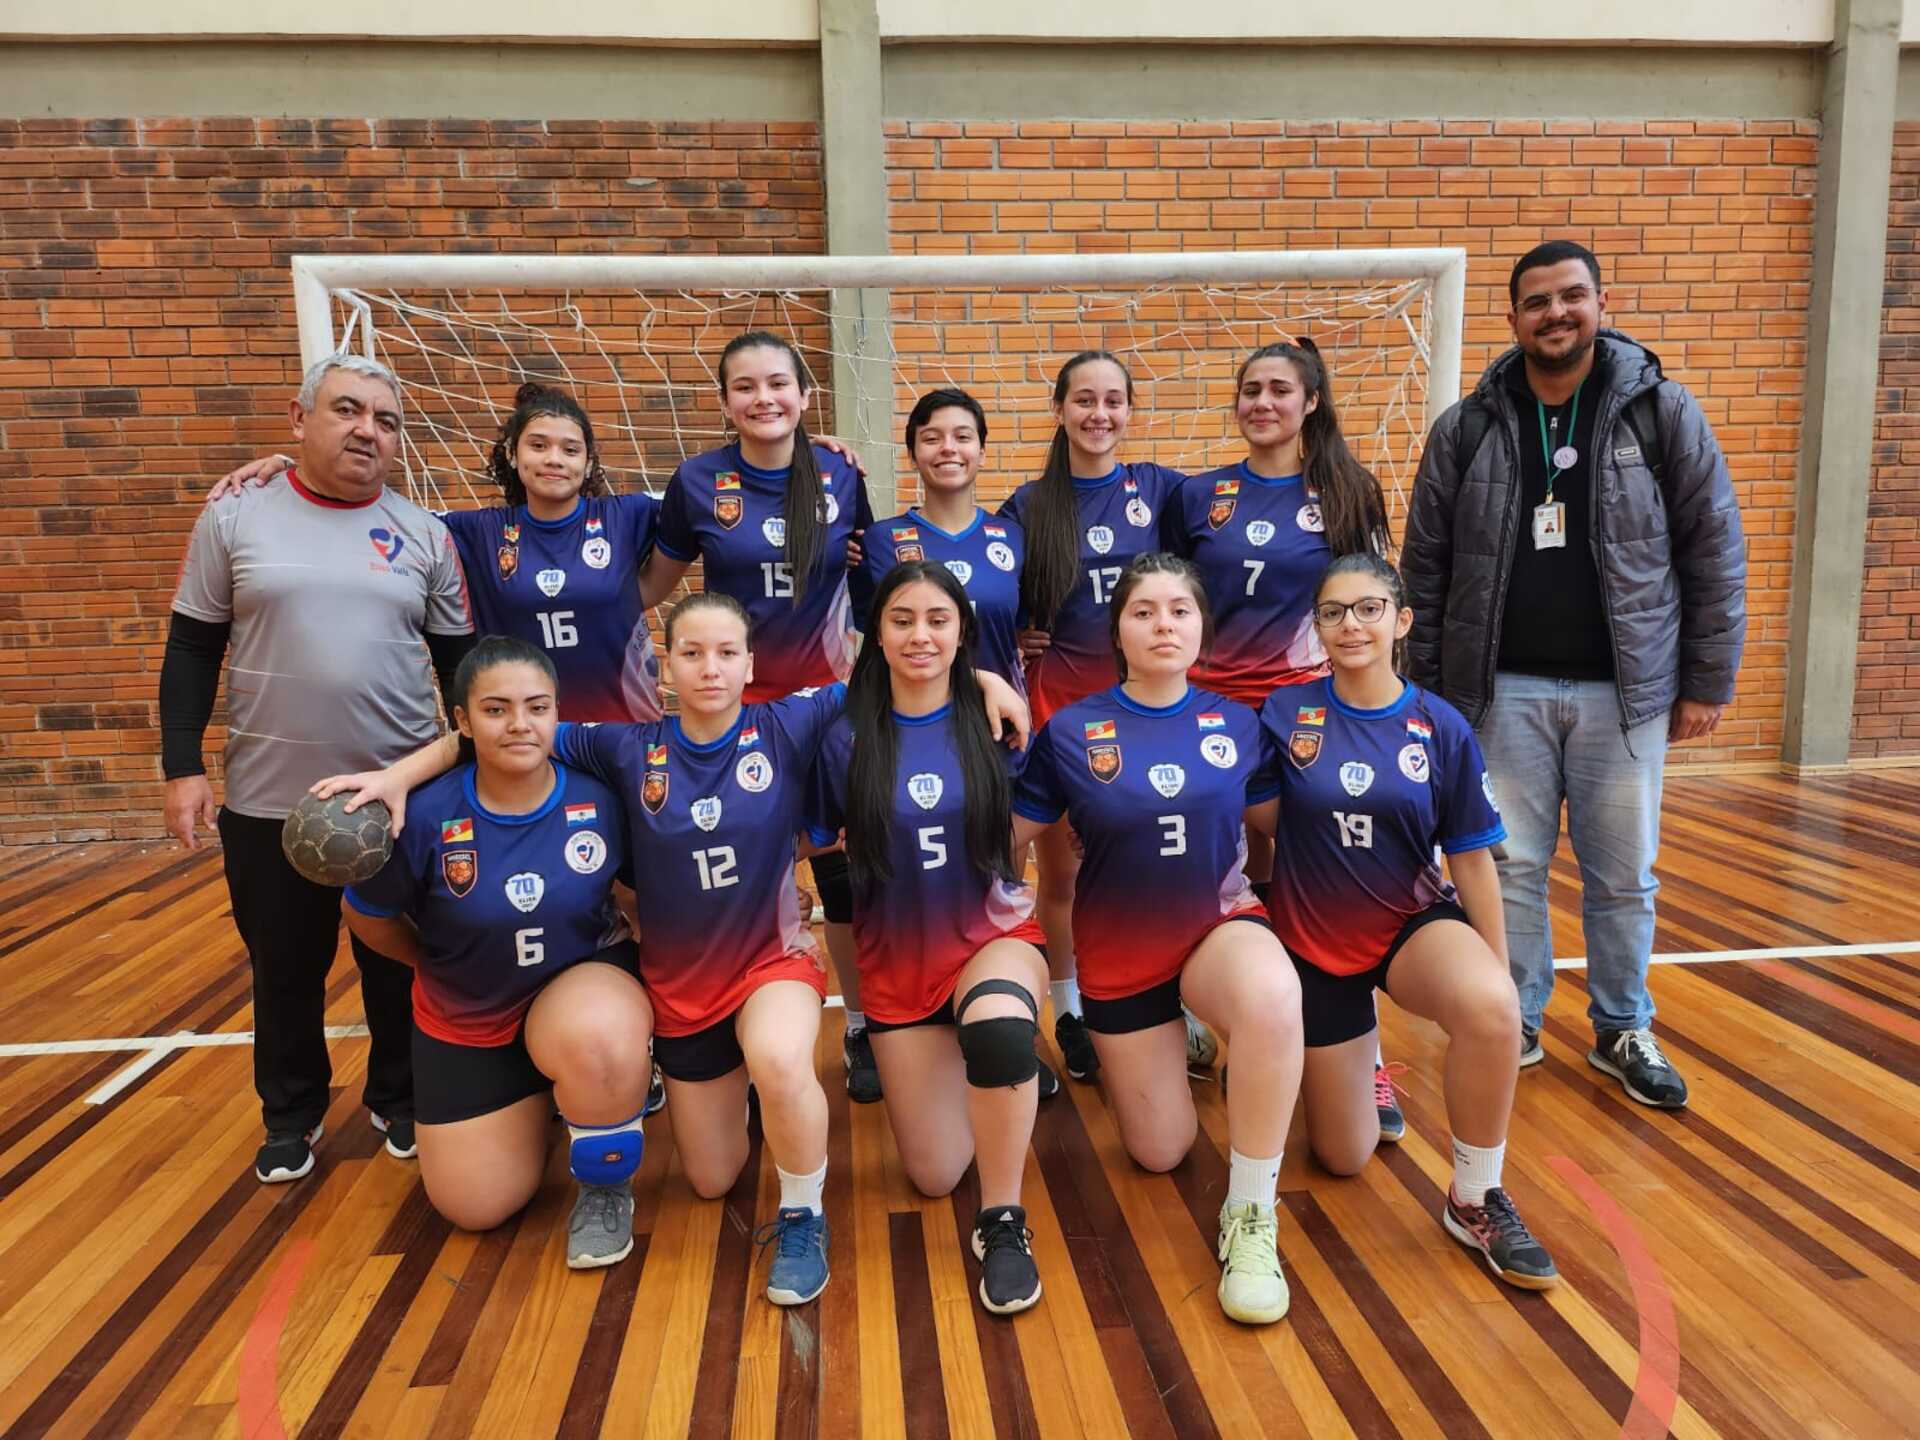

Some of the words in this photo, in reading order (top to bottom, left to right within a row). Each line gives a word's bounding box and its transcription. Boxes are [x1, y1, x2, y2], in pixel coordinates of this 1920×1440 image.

[760, 562, 794, 598] 15
[1243, 559, 1265, 596] 7
[535, 610, 579, 649] 16
[913, 777, 936, 793] 70
[1154, 767, 1178, 784] 70
[1346, 765, 1367, 783] 70
[917, 825, 948, 870] 5
[1157, 814, 1187, 857] 3
[1332, 810, 1373, 849] 19
[511, 877, 536, 895] 70
[692, 845, 740, 891] 12
[514, 927, 545, 967] 6
